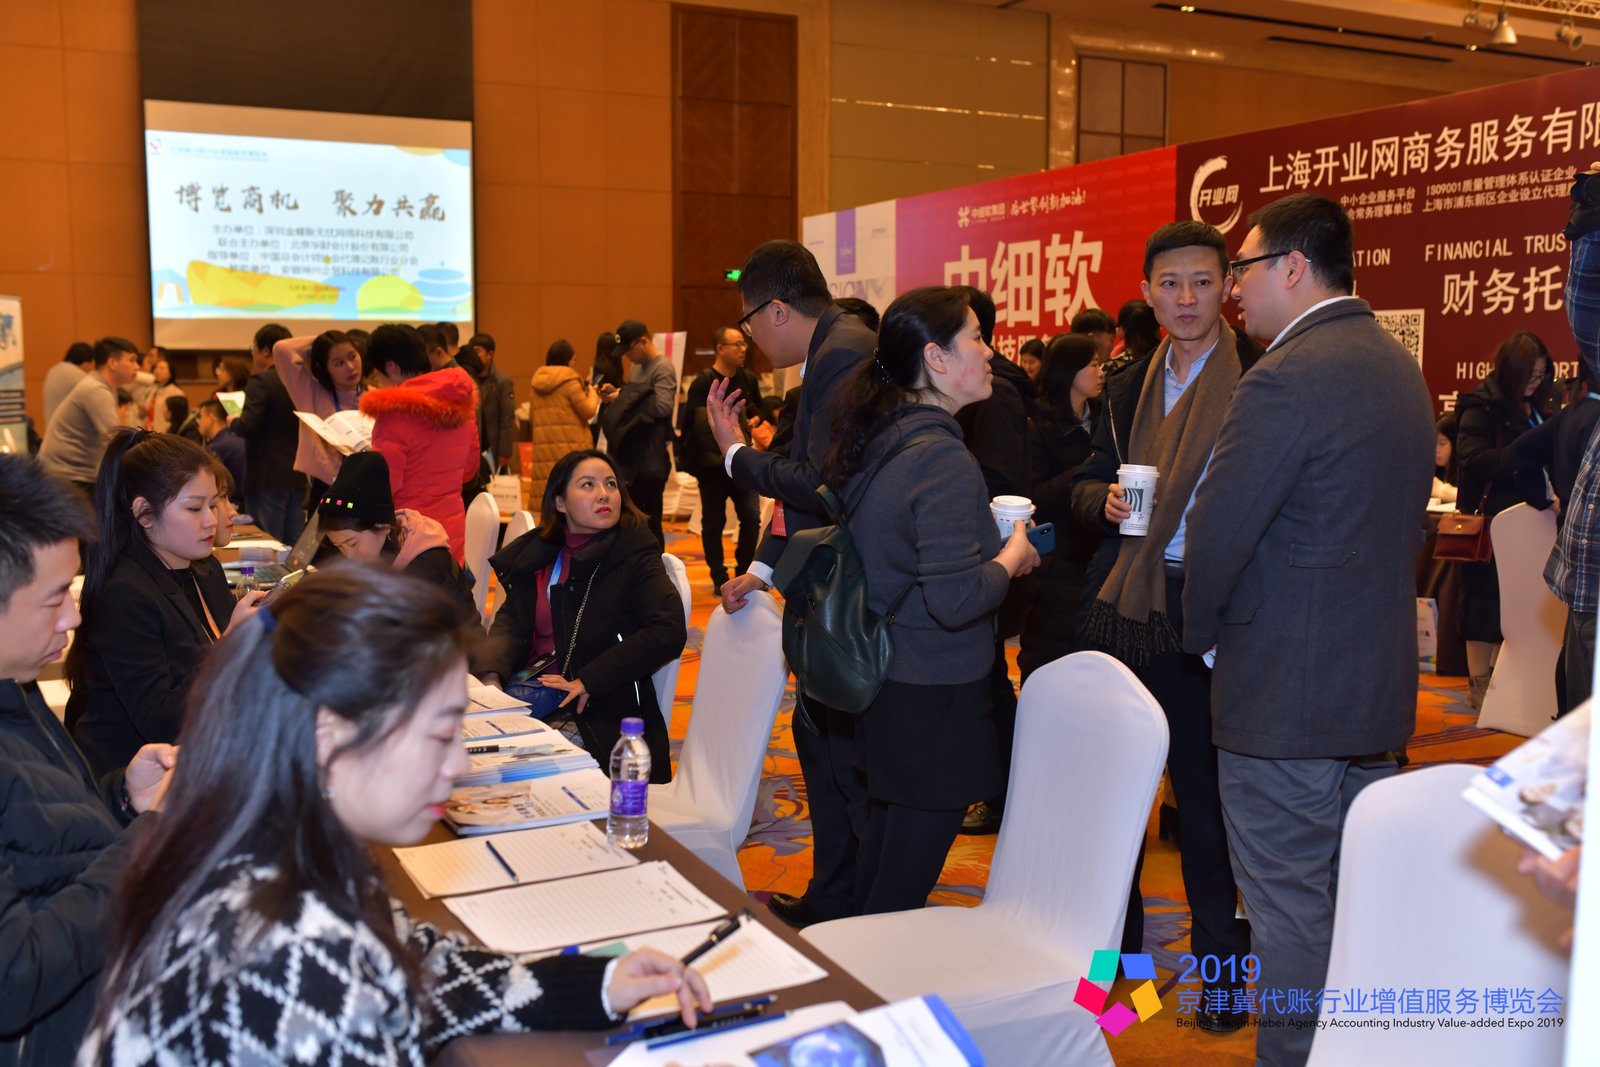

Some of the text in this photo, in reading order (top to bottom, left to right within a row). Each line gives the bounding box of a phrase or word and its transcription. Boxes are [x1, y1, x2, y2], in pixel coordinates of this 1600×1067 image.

[1259, 101, 1600, 194] 上海开业网商务服务有限
[174, 181, 447, 222] 博览商机 聚力共赢
[1198, 184, 1240, 208] 开业网
[1340, 186, 1417, 208] 中小企业服务平台
[1422, 182, 1572, 213] 上海市浦东新区企业设立代理
[1424, 238, 1513, 263] FINANCIAL
[1441, 265, 1565, 316] 财务托
